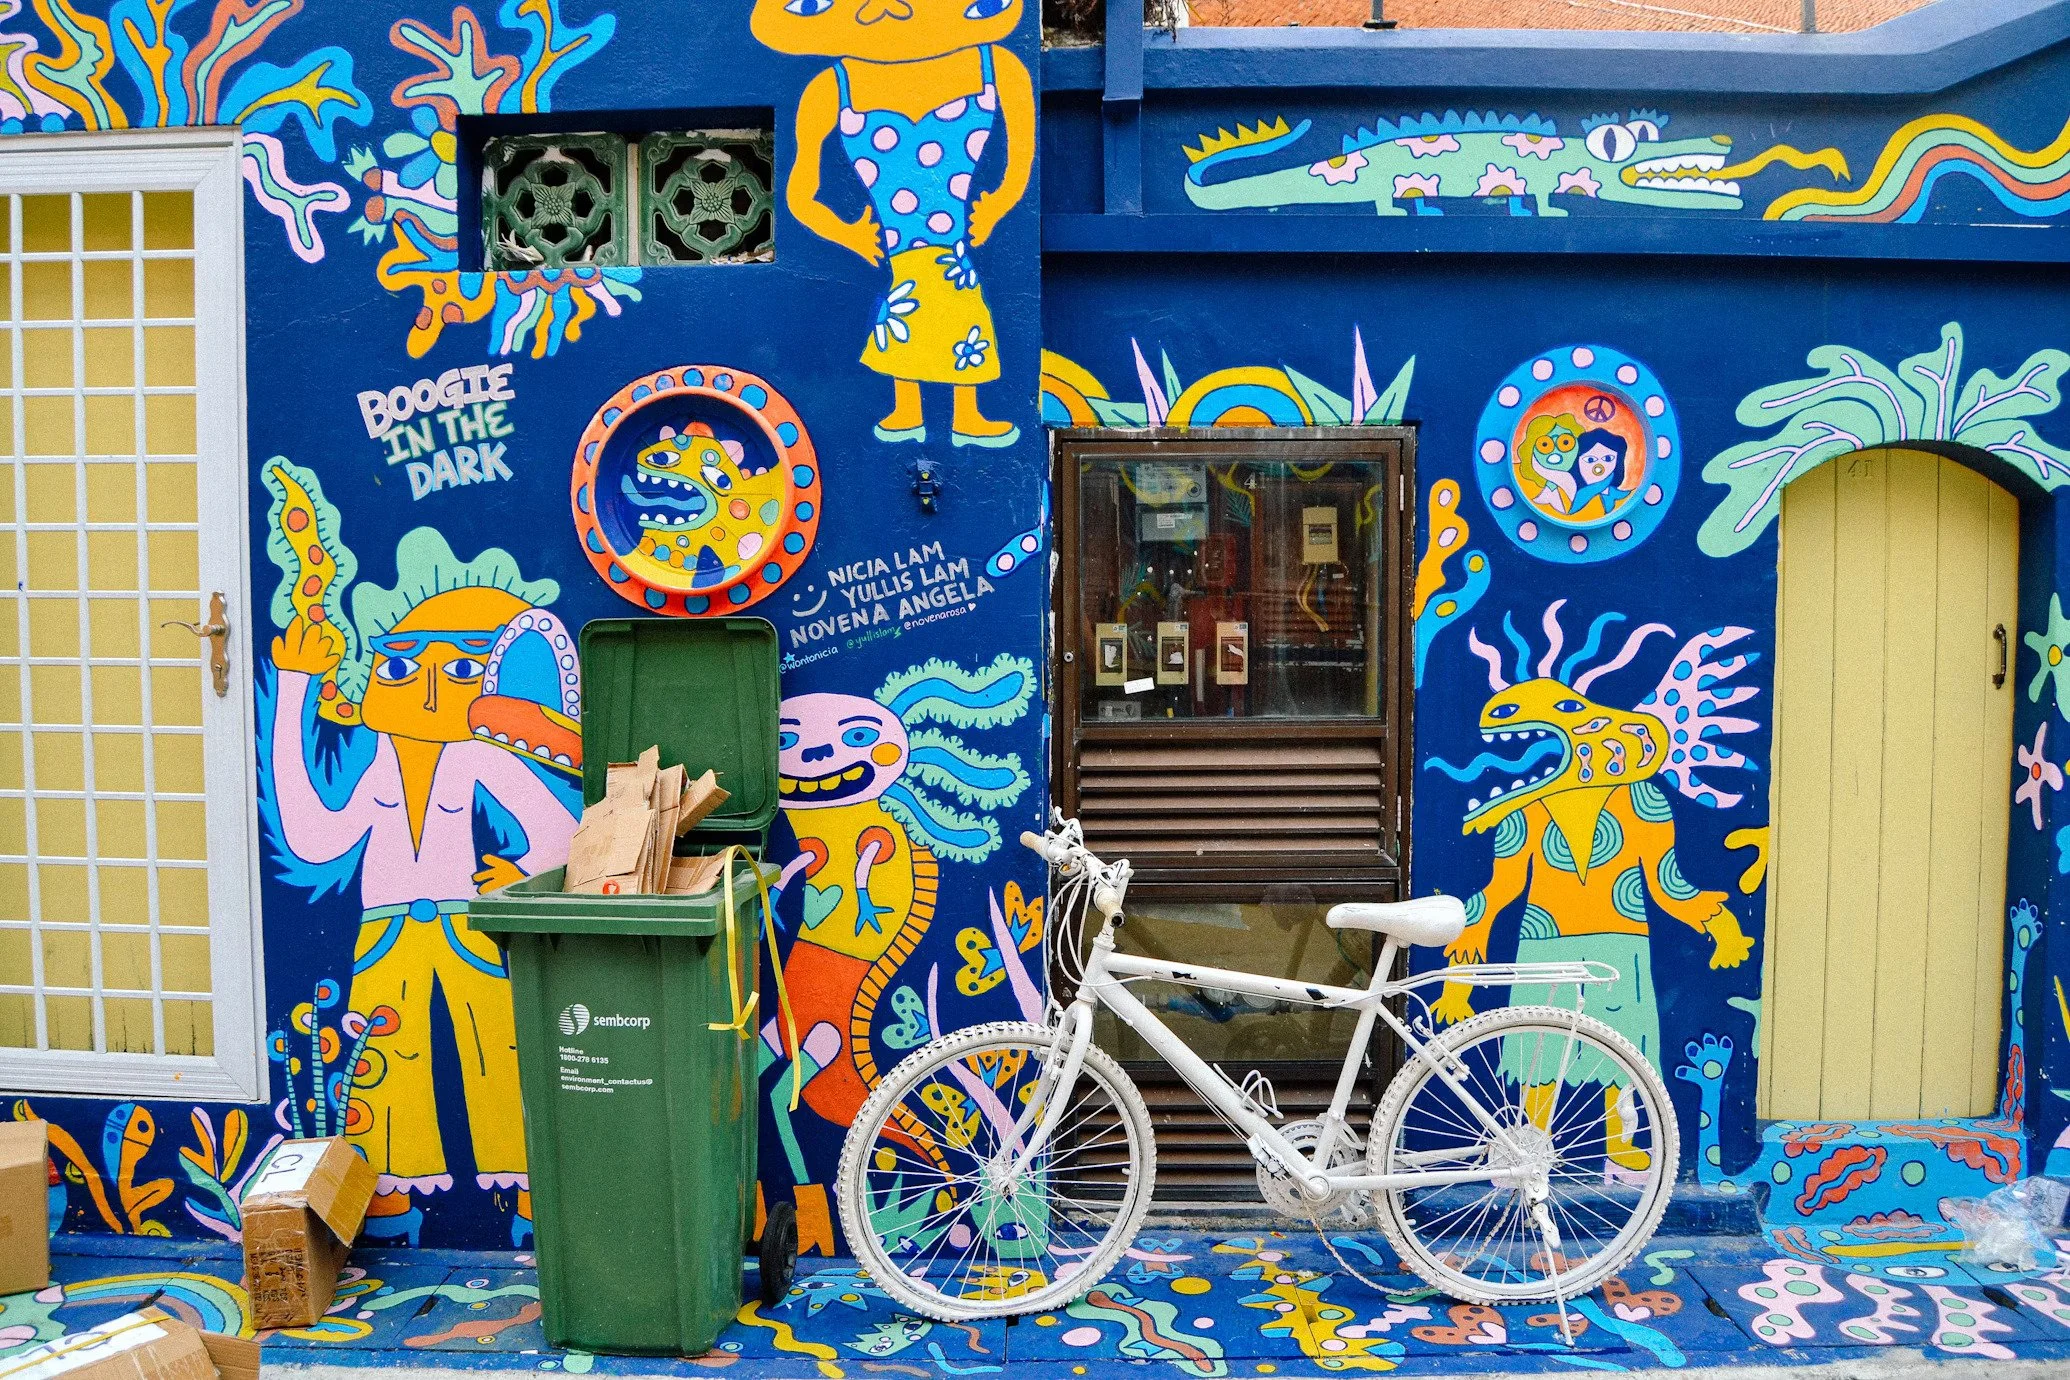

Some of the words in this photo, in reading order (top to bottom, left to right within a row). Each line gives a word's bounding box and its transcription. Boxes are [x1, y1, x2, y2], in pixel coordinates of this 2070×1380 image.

[356, 362, 516, 439] BOOGIE
[381, 417, 436, 466] IN
[436, 401, 515, 444] THE
[405, 441, 514, 501] DARK
[827, 557, 890, 587] NICIA
[894, 541, 945, 570] LAM
[840, 571, 914, 609] YULLIS
[920, 557, 970, 585] LAM
[789, 603, 890, 649] NOVENA
[899, 575, 995, 620] ANGELA
[778, 646, 839, 674] @wontonicia
[903, 607, 967, 631] @novenarosa
[593, 1013, 651, 1030] sembcorp
[559, 1046, 584, 1055] Hotline
[560, 1054, 590, 1063] 1800-278
[560, 1066, 579, 1075] Email
[560, 1075, 653, 1085] environment_contactus@
[561, 1083, 614, 1093] sembcorp.com
